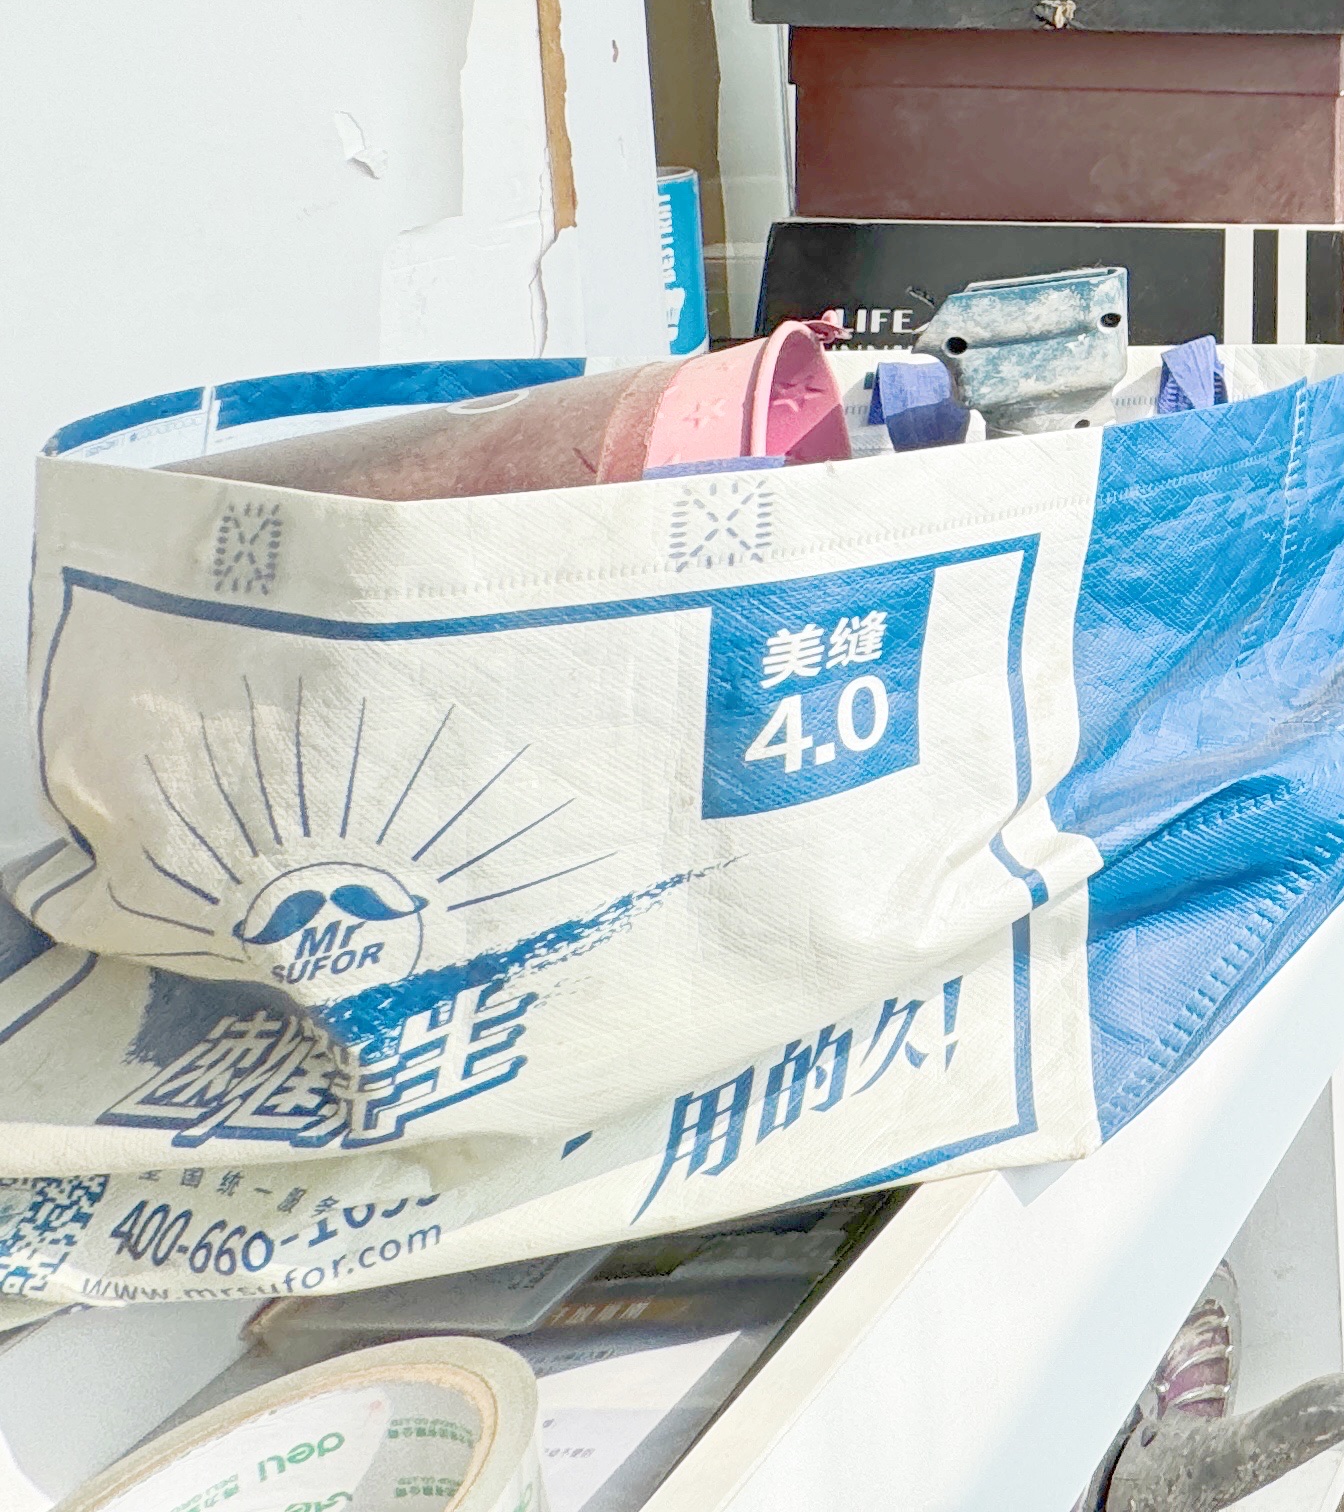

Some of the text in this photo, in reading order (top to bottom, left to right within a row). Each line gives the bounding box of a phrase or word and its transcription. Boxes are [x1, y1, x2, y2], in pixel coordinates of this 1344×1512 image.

[835, 308, 914, 335] LIFE
[759, 609, 888, 688] 美缝
[744, 675, 890, 774] 4.0
[294, 919, 365, 962] Mr
[270, 941, 387, 986] SUFOR
